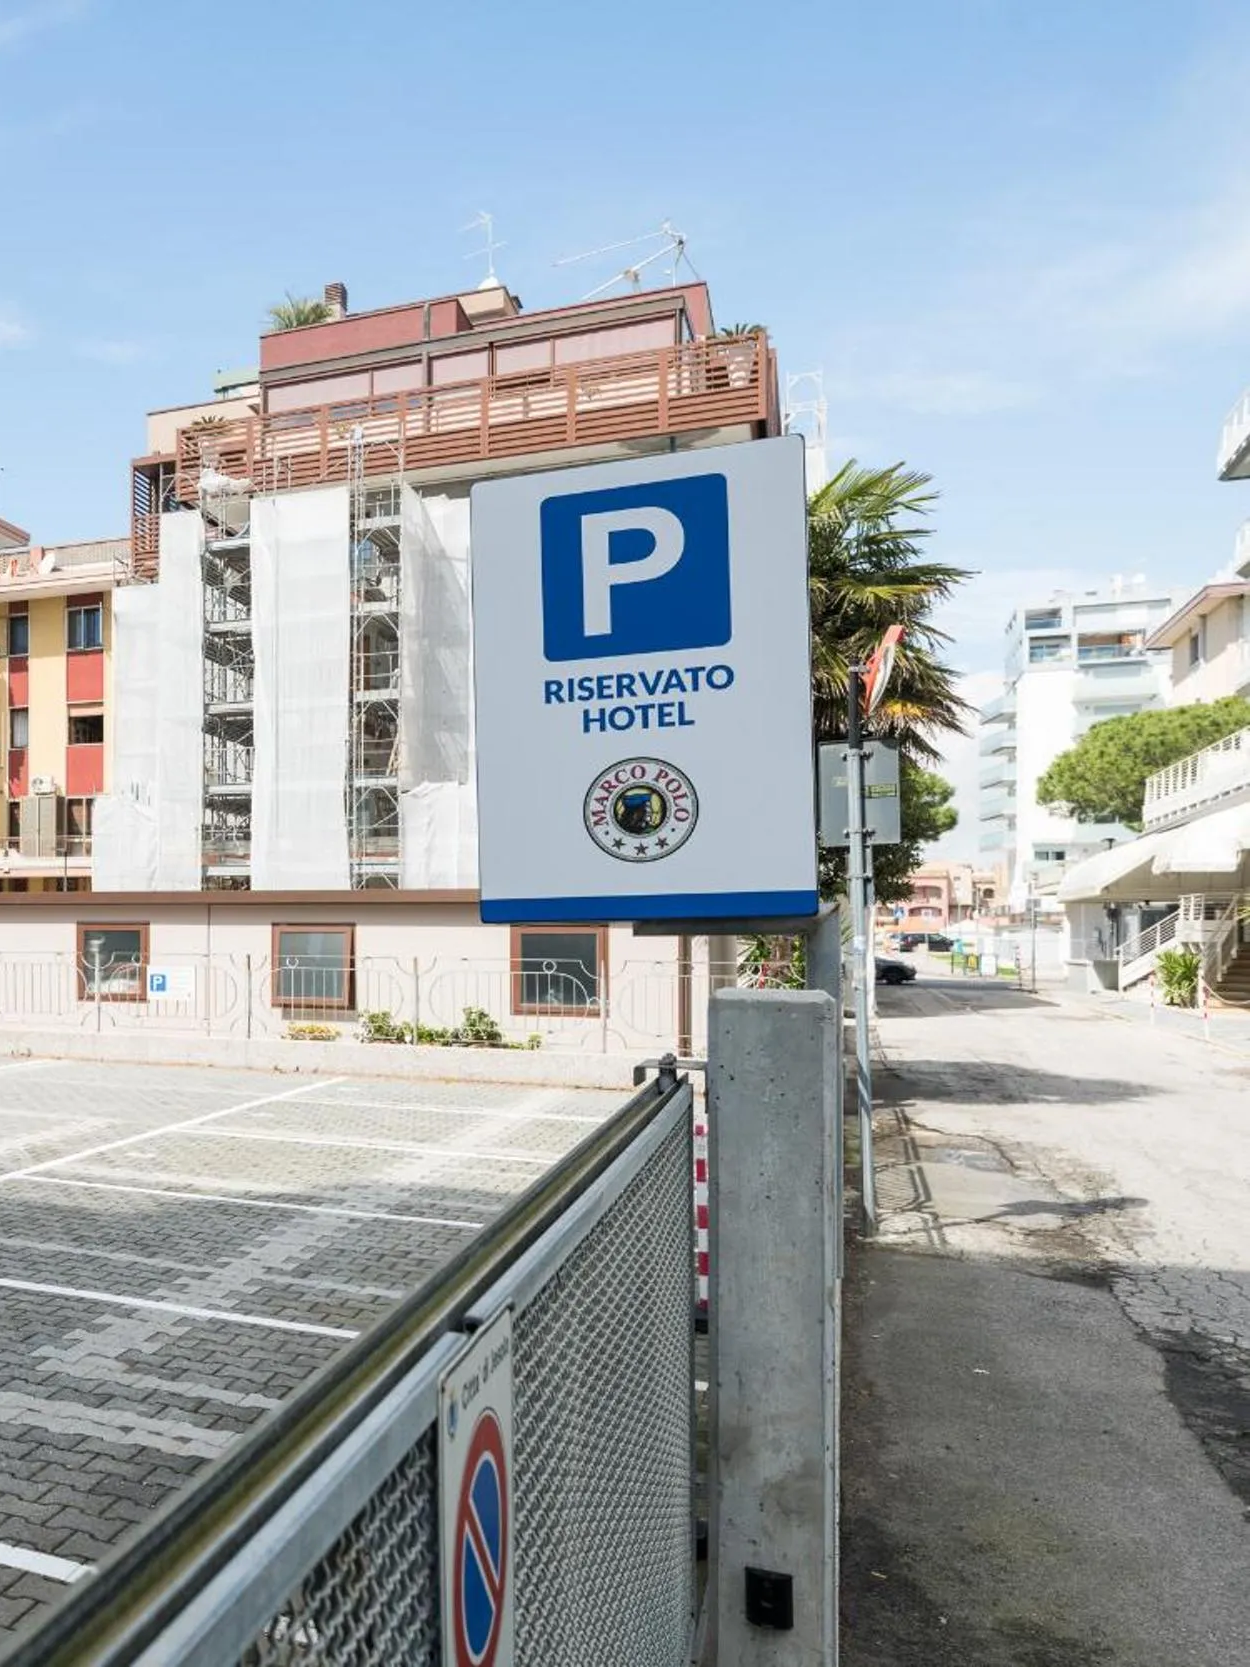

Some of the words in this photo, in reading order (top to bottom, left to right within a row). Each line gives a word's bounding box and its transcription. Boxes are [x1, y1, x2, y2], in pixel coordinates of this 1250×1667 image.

[581, 506, 685, 637] P
[543, 664, 735, 705] RISERVATO
[582, 701, 695, 733] HOTEL
[591, 765, 647, 827] MARCO
[651, 768, 690, 822] POLO
[152, 975, 163, 991] P
